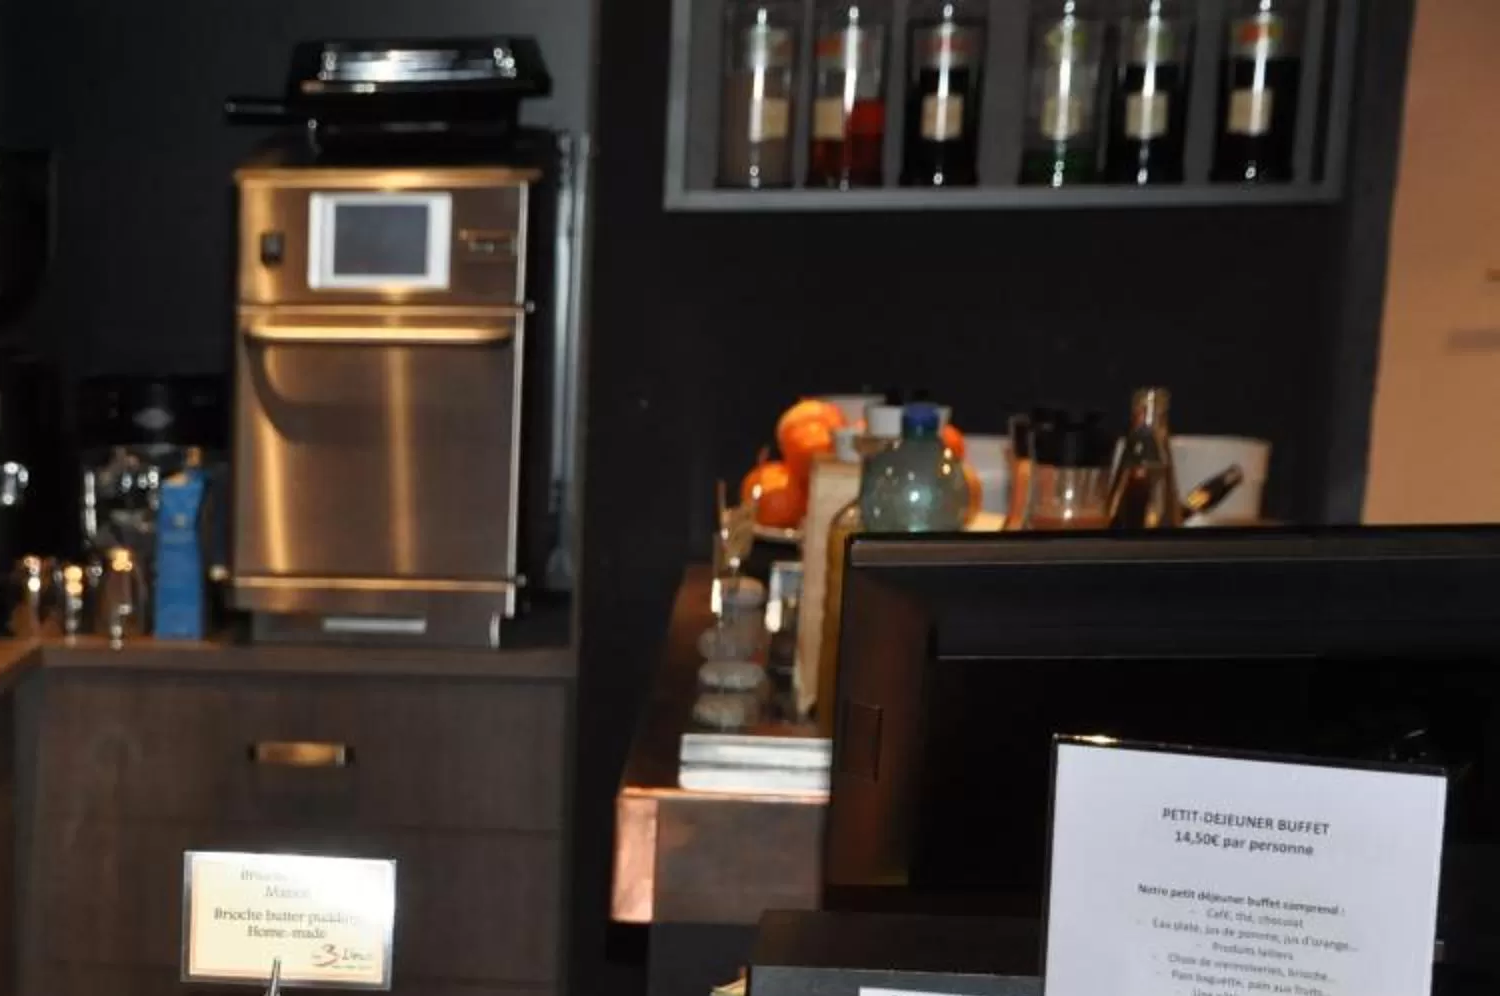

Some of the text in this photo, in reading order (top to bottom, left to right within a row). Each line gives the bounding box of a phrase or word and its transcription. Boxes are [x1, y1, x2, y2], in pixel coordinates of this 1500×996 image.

[1277, 819, 1330, 835] BUFFET
[1175, 830, 1314, 855] 14,50€ par personne
[1170, 888, 1196, 901] petit
[1247, 895, 1280, 909] buffet
[214, 906, 262, 921] Brioche
